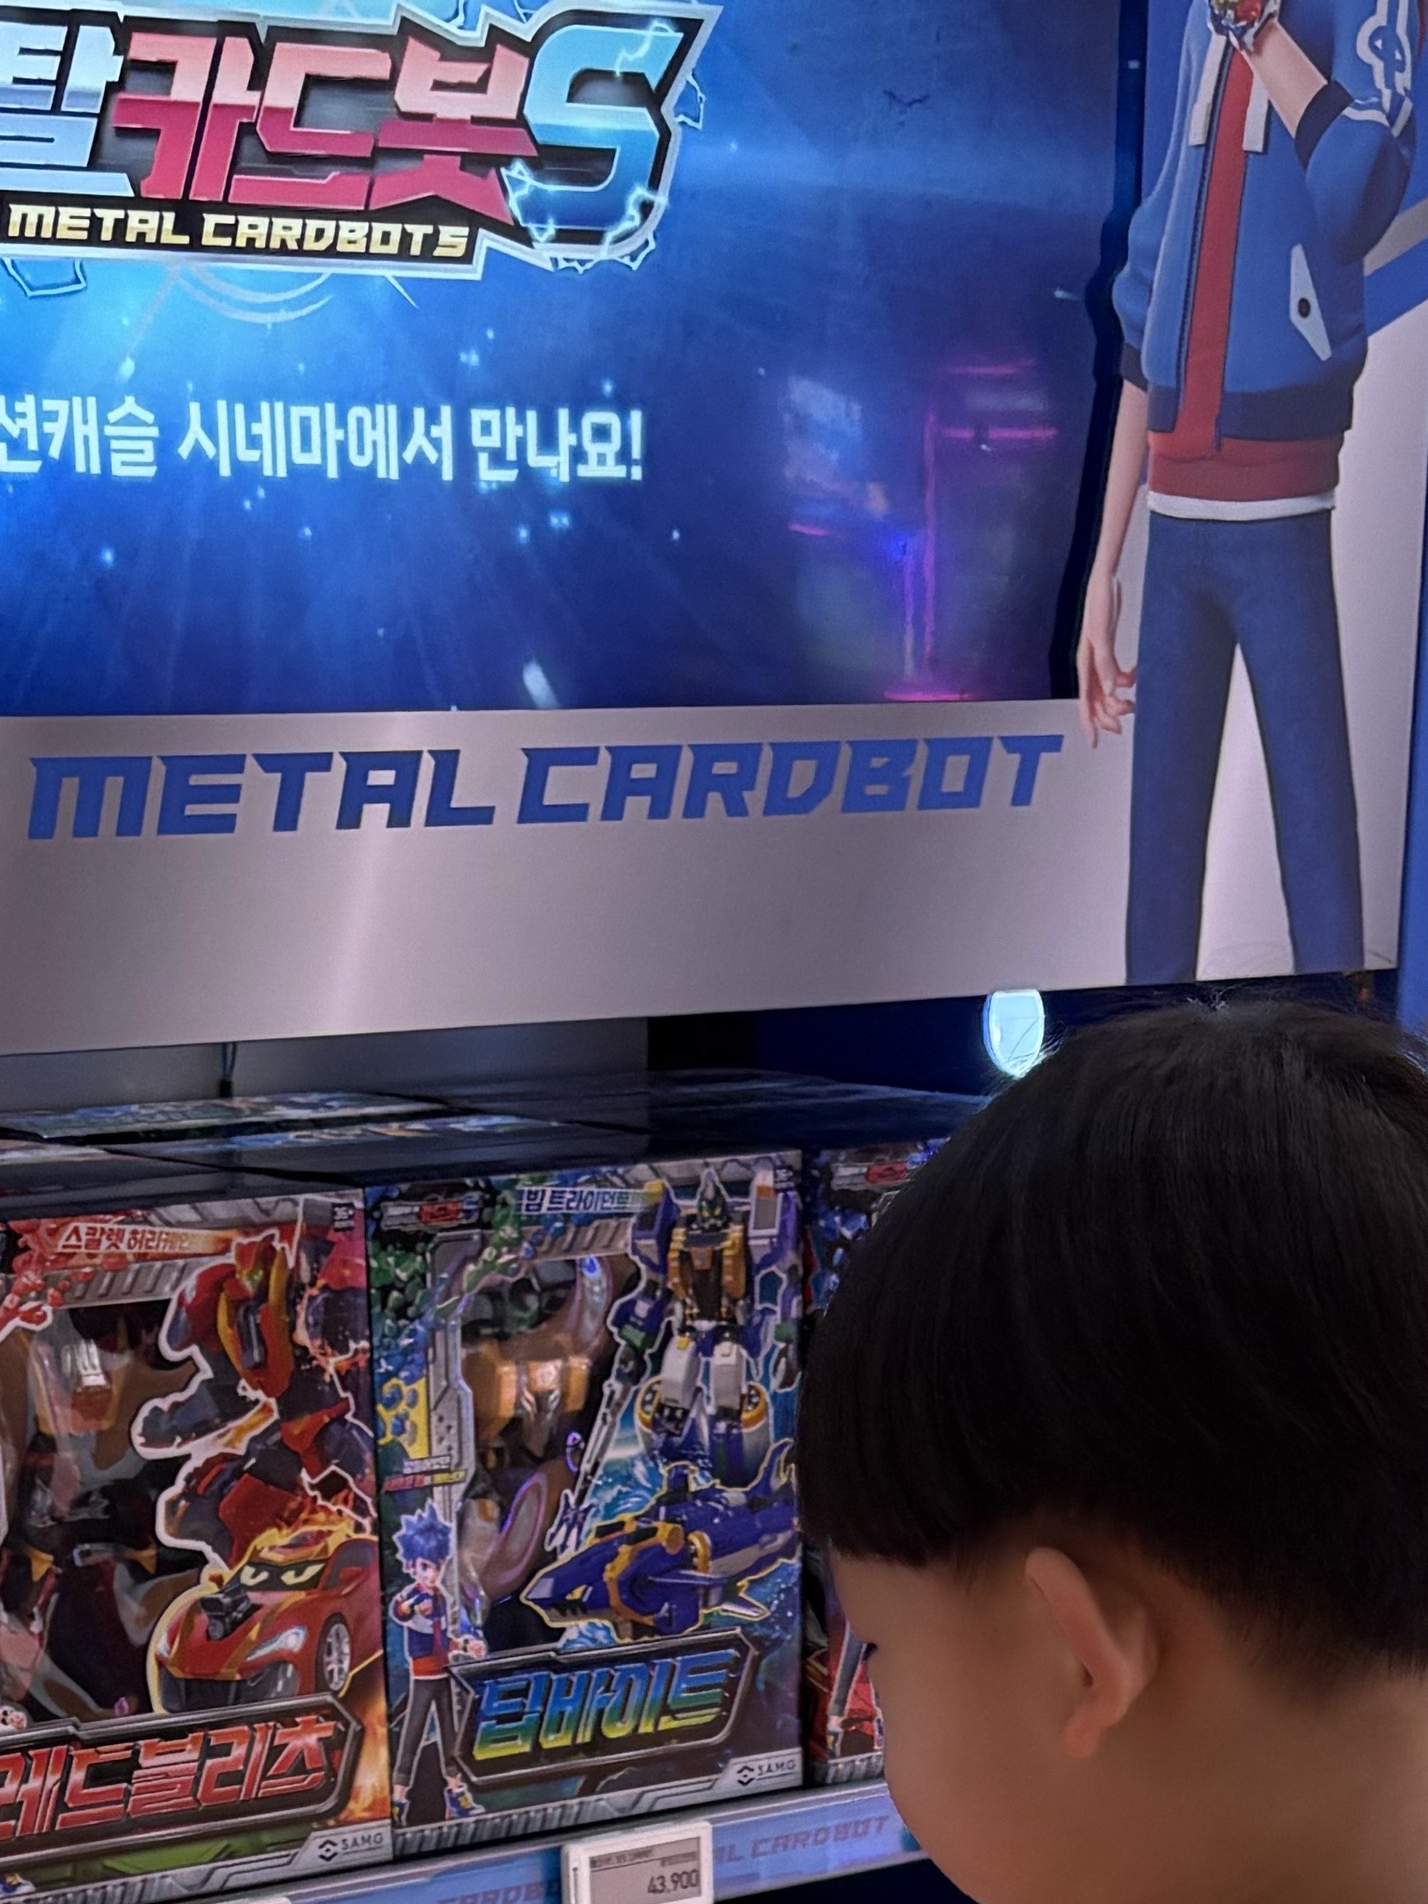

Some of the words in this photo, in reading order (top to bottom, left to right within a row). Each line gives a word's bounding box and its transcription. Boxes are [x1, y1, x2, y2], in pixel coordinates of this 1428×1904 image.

[7, 203, 192, 247] METAL
[201, 212, 470, 259] CARDBOTS
[176, 400, 453, 481] 시네마에서
[470, 406, 644, 482] 만나요!
[27, 746, 496, 841] METAL
[517, 733, 1064, 826] CARDBOT
[61, 1224, 124, 1251] 스칼렛
[340, 1832, 384, 1853] SAMG
